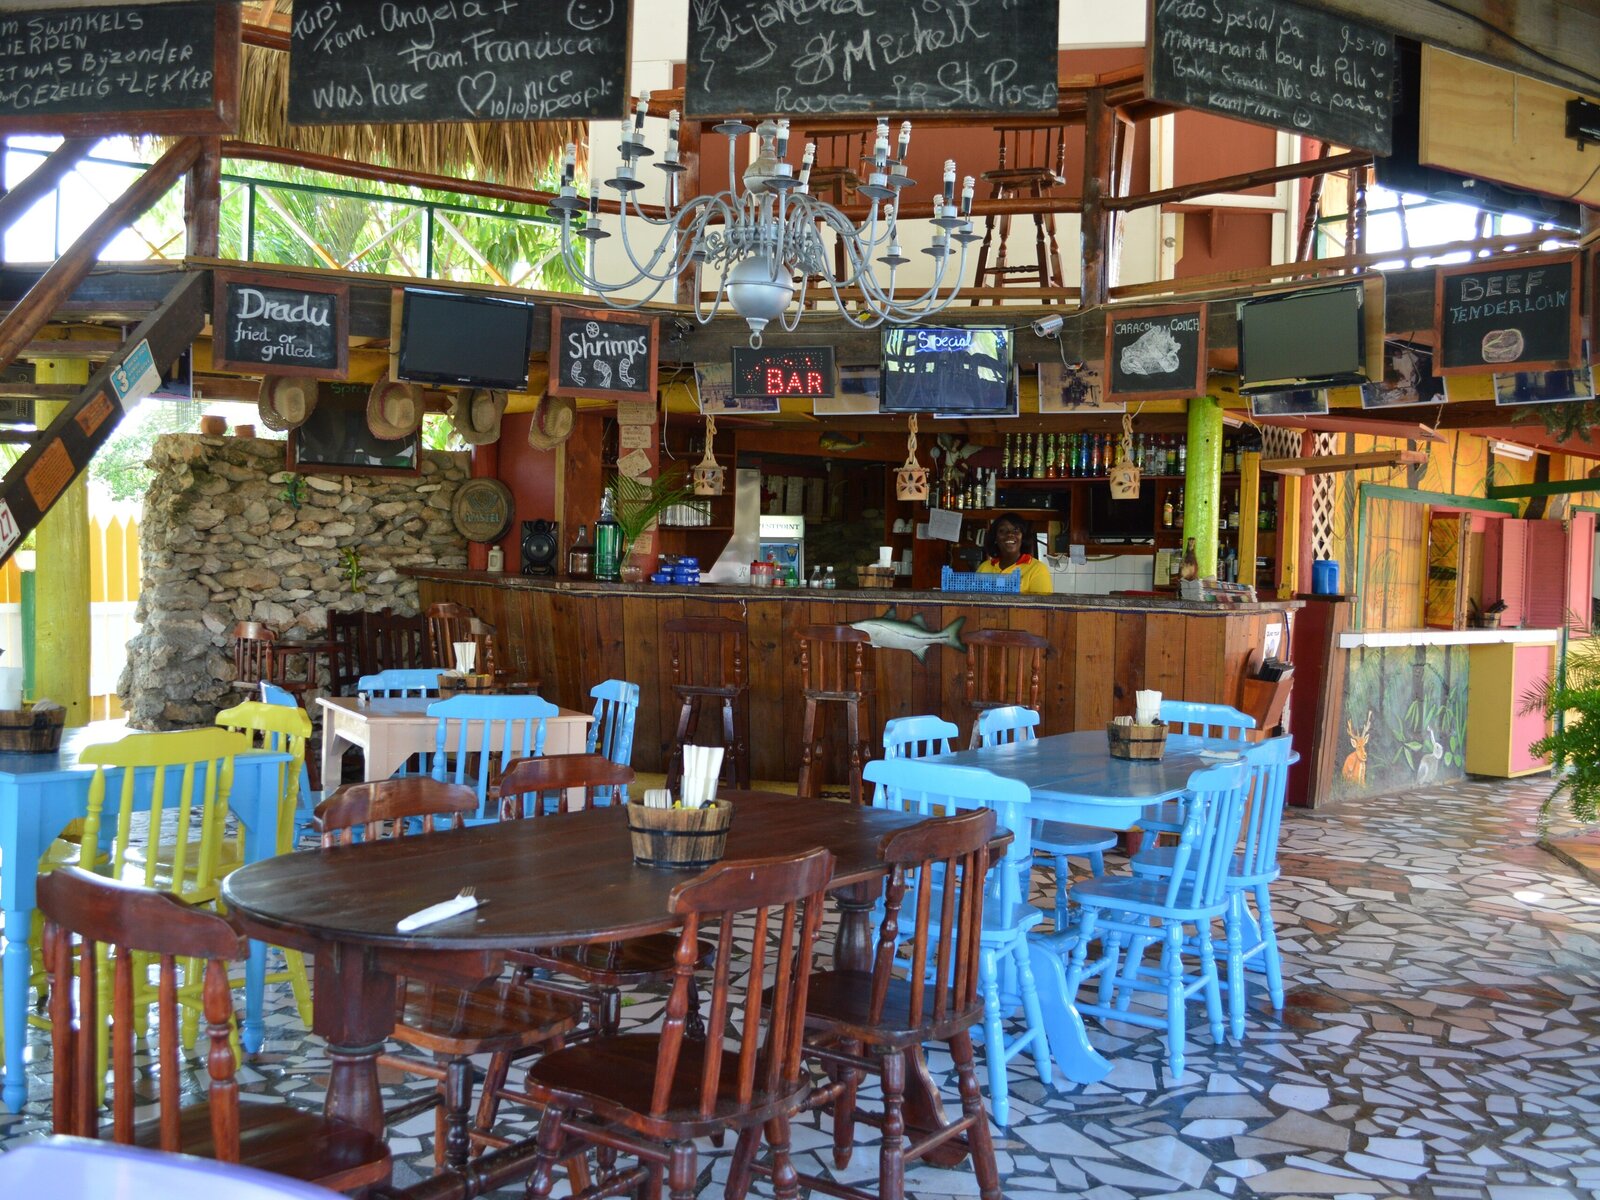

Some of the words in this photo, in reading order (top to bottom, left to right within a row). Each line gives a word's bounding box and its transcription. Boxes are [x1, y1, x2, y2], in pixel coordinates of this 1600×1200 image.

[365, 65, 428, 105] here
[524, 70, 573, 100] nice
[1460, 270, 1546, 302] BEEF
[236, 288, 331, 327] Dradu
[1450, 289, 1569, 324] TENDERLOIN
[234, 321, 271, 343] fried
[278, 334, 298, 343] or
[1170, 318, 1200, 331] CONCH
[261, 343, 317, 362] grilled
[568, 332, 648, 364] Shrimps
[767, 368, 822, 395] BAR
